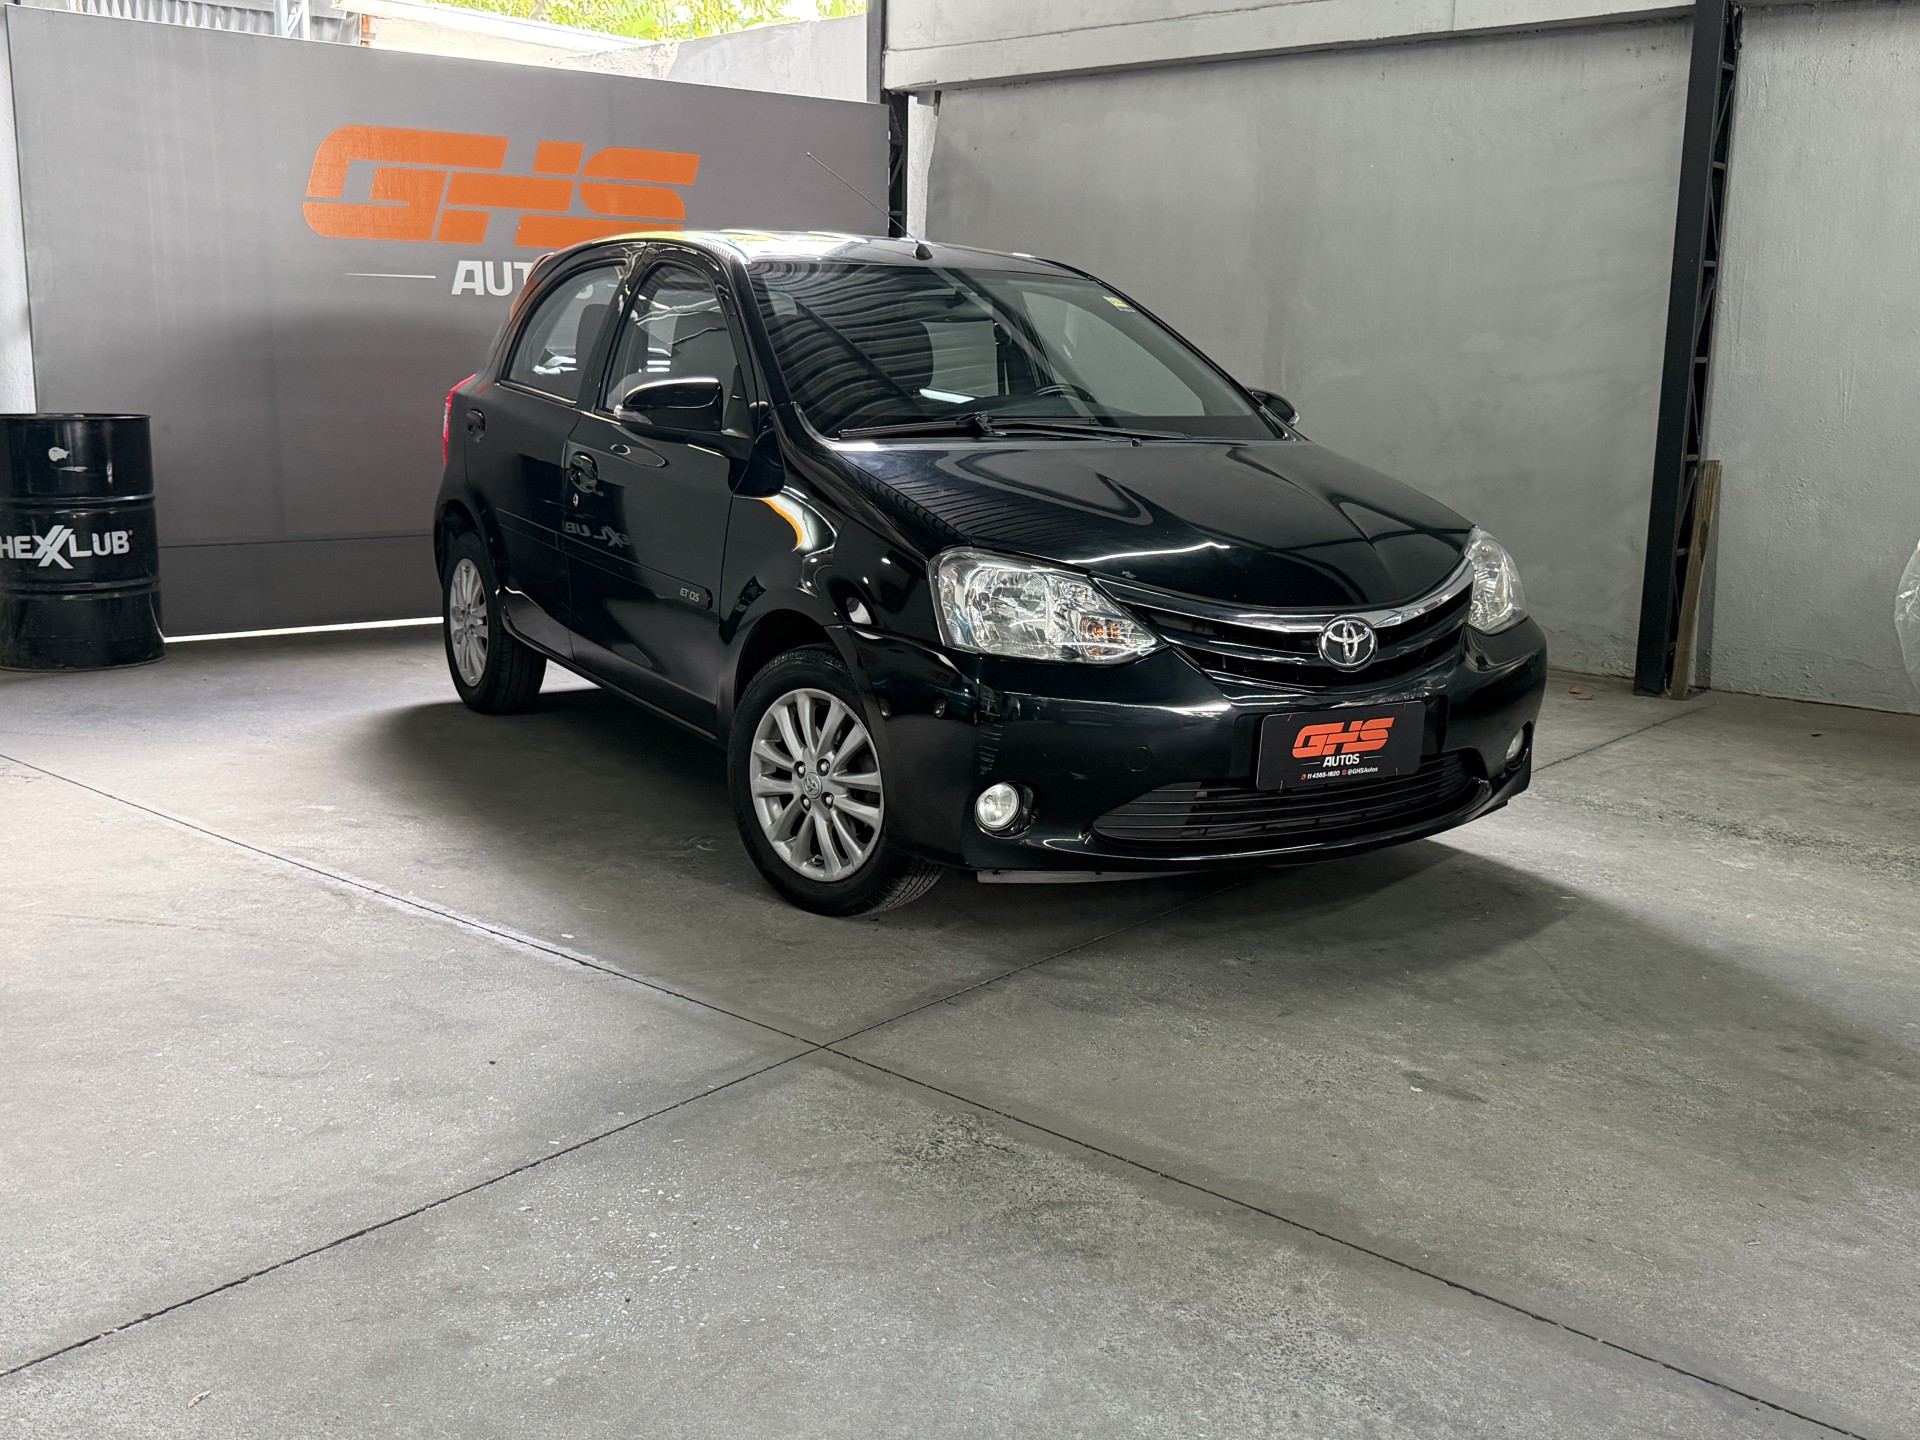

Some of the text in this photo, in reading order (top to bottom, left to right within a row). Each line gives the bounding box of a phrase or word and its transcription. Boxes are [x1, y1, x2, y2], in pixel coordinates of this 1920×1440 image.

[303, 124, 700, 248] GHS
[452, 260, 536, 297] AUT
[1292, 717, 1395, 759] GHS
[1322, 753, 1360, 768] AUTOS
